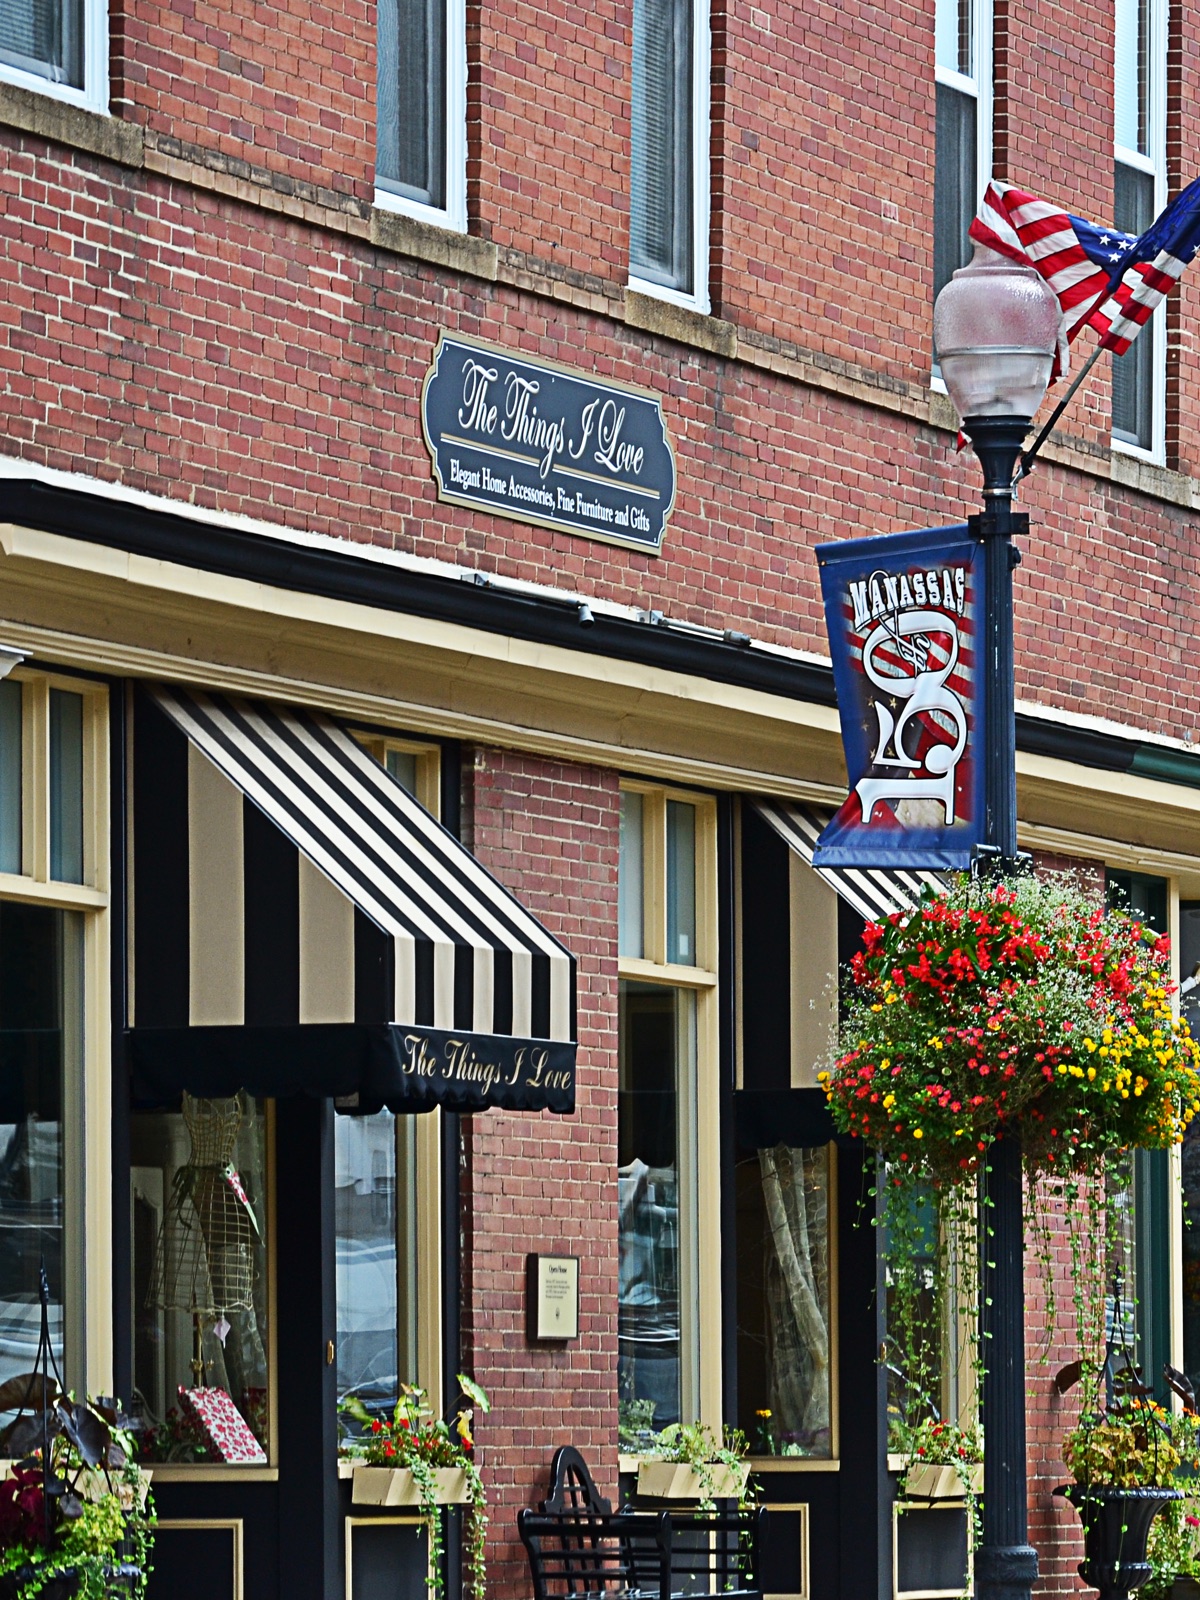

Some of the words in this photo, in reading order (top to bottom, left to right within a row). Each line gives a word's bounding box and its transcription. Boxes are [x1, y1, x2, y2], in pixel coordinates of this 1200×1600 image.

[457, 358, 499, 434] The
[501, 371, 565, 479] Things
[568, 398, 600, 459] I
[594, 399, 644, 475] Love
[450, 458, 481, 490] Elegant
[481, 466, 507, 495] Home
[508, 474, 556, 511] Accessories,
[556, 486, 575, 513] Fine
[576, 491, 614, 523] Furniture
[614, 504, 629, 527] and
[630, 506, 651, 532] Gifts
[849, 567, 965, 633] MANASSAS
[402, 1033, 437, 1078] The
[441, 1039, 501, 1096] Things
[504, 1046, 528, 1086] I
[525, 1046, 572, 1091] Love
